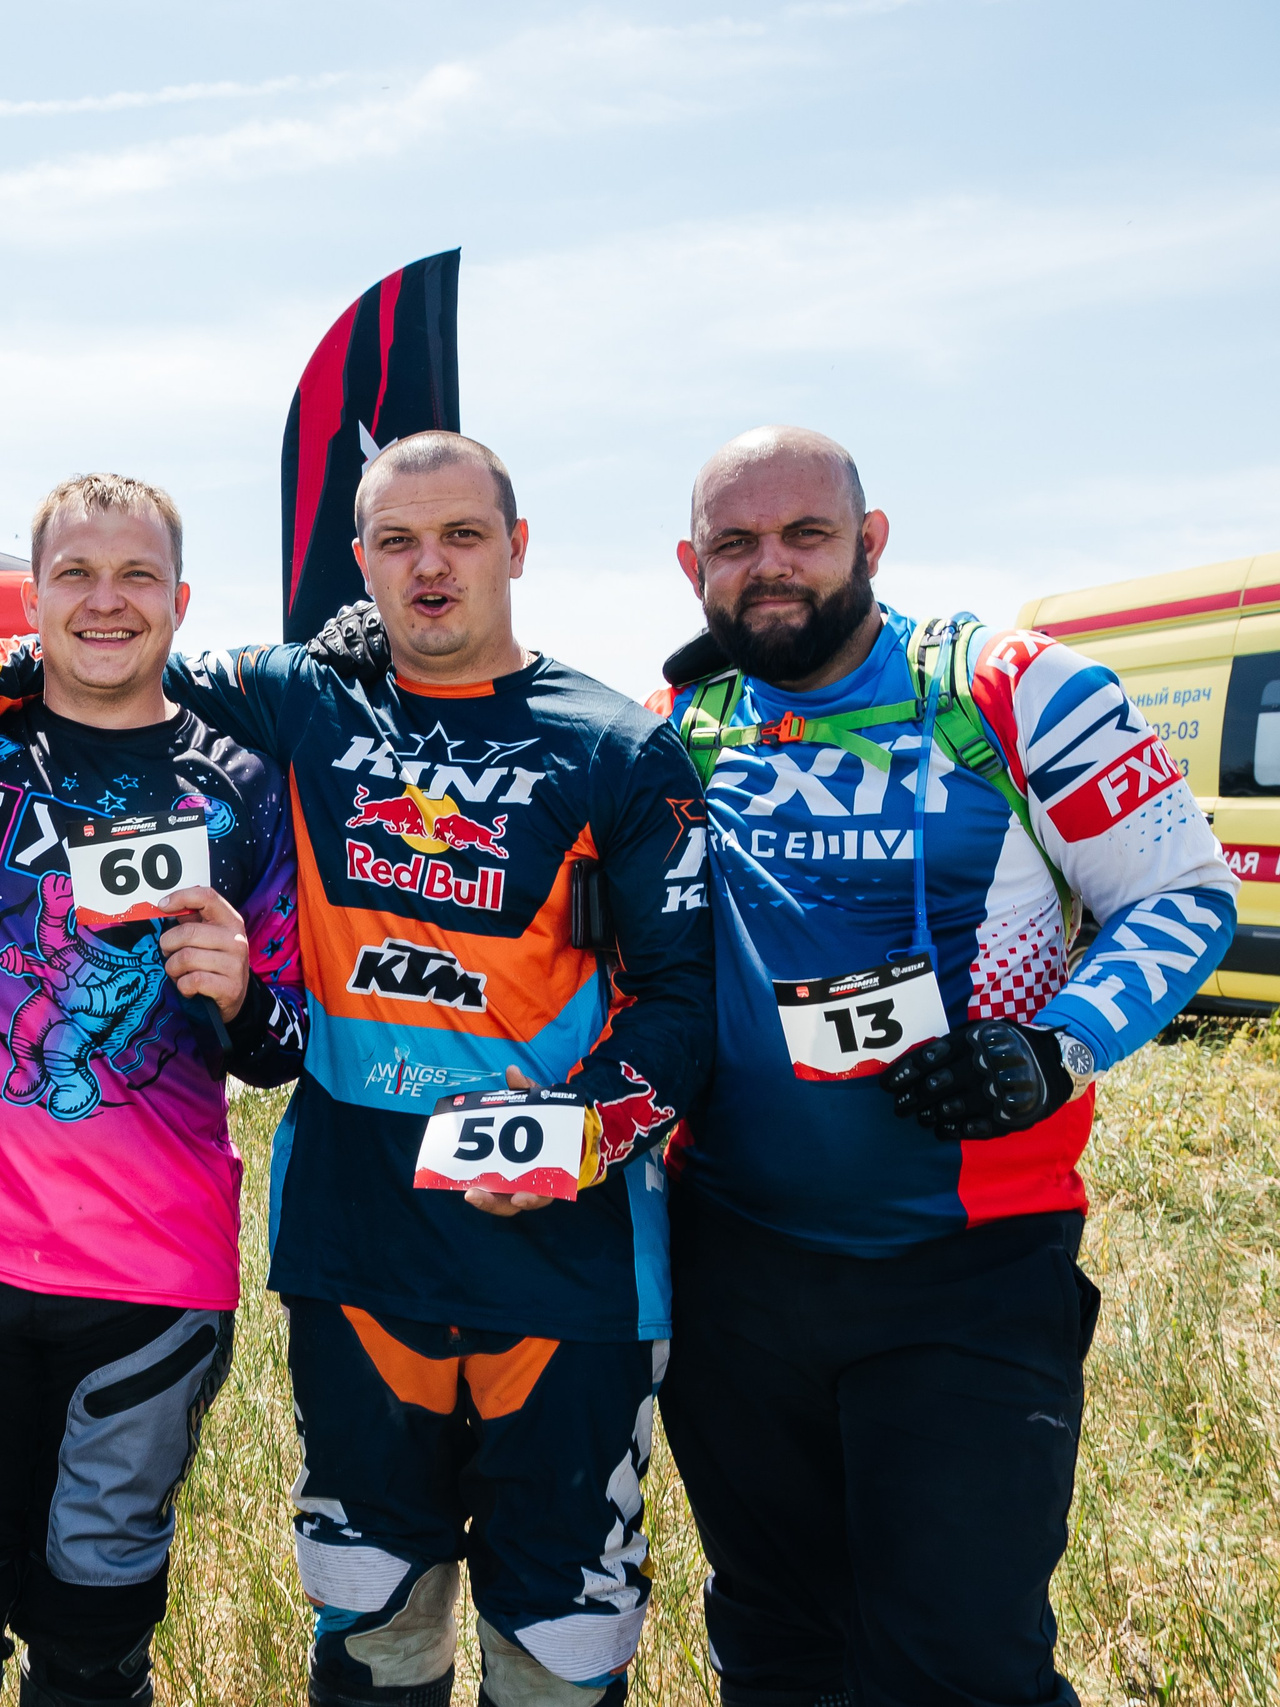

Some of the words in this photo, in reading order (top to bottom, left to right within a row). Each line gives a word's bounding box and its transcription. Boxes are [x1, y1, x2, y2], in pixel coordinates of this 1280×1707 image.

[1172, 686, 1213, 708] врач
[332, 735, 546, 805] KINI
[110, 821, 158, 834] SHARMAX
[100, 843, 183, 896] 60
[346, 838, 421, 893] Red
[423, 859, 506, 912] Bull
[346, 937, 488, 1013] KTM
[828, 976, 880, 994] SHARMAX
[1059, 892, 1223, 1034] FXR
[823, 998, 904, 1053] 13
[377, 1062, 448, 1084] WINGS
[384, 1079, 425, 1098] LIFE
[453, 1115, 544, 1164] 50
